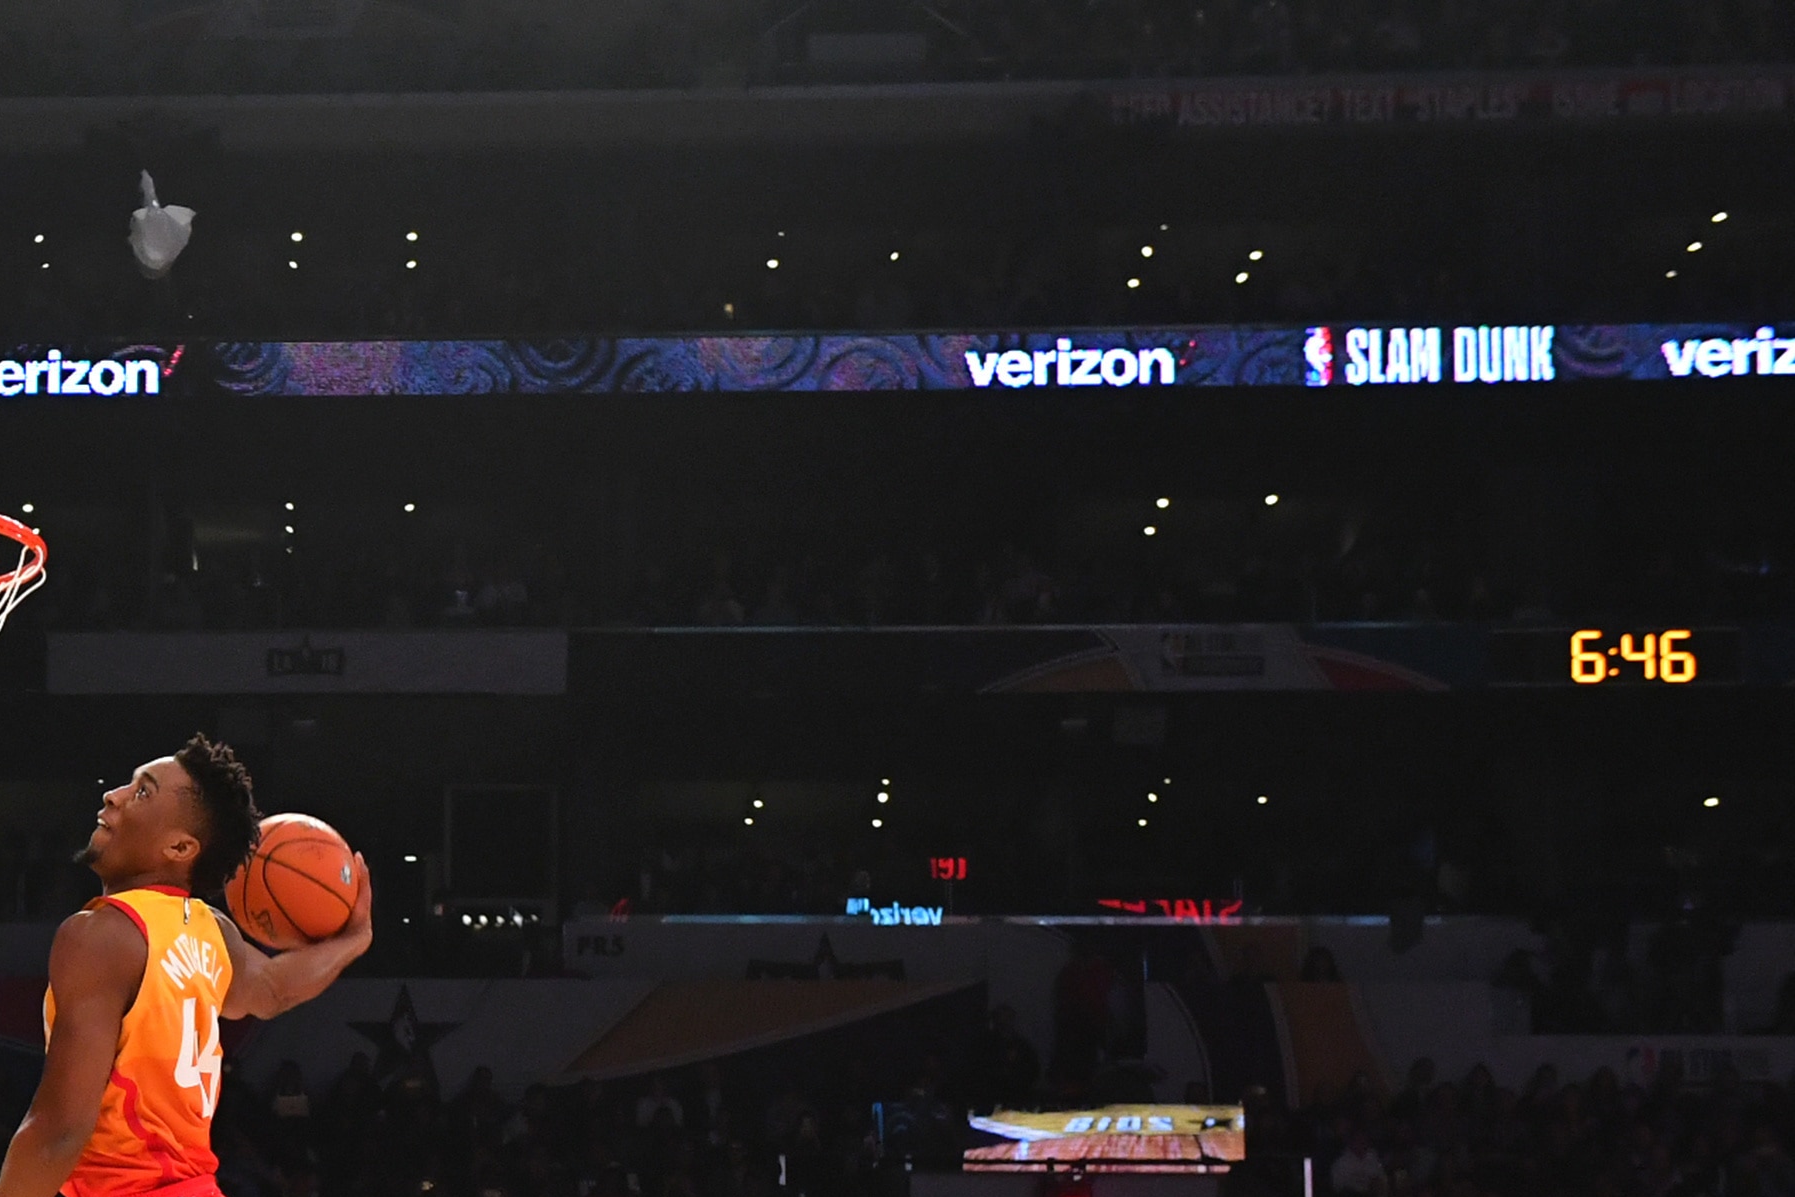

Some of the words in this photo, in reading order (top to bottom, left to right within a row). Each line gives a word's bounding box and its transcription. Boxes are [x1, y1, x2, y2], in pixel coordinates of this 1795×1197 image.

[964, 338, 1175, 387] verizon
[1345, 327, 1441, 385] SLAM
[1453, 325, 1555, 384] DUNK
[1570, 629, 1697, 684] 6:46
